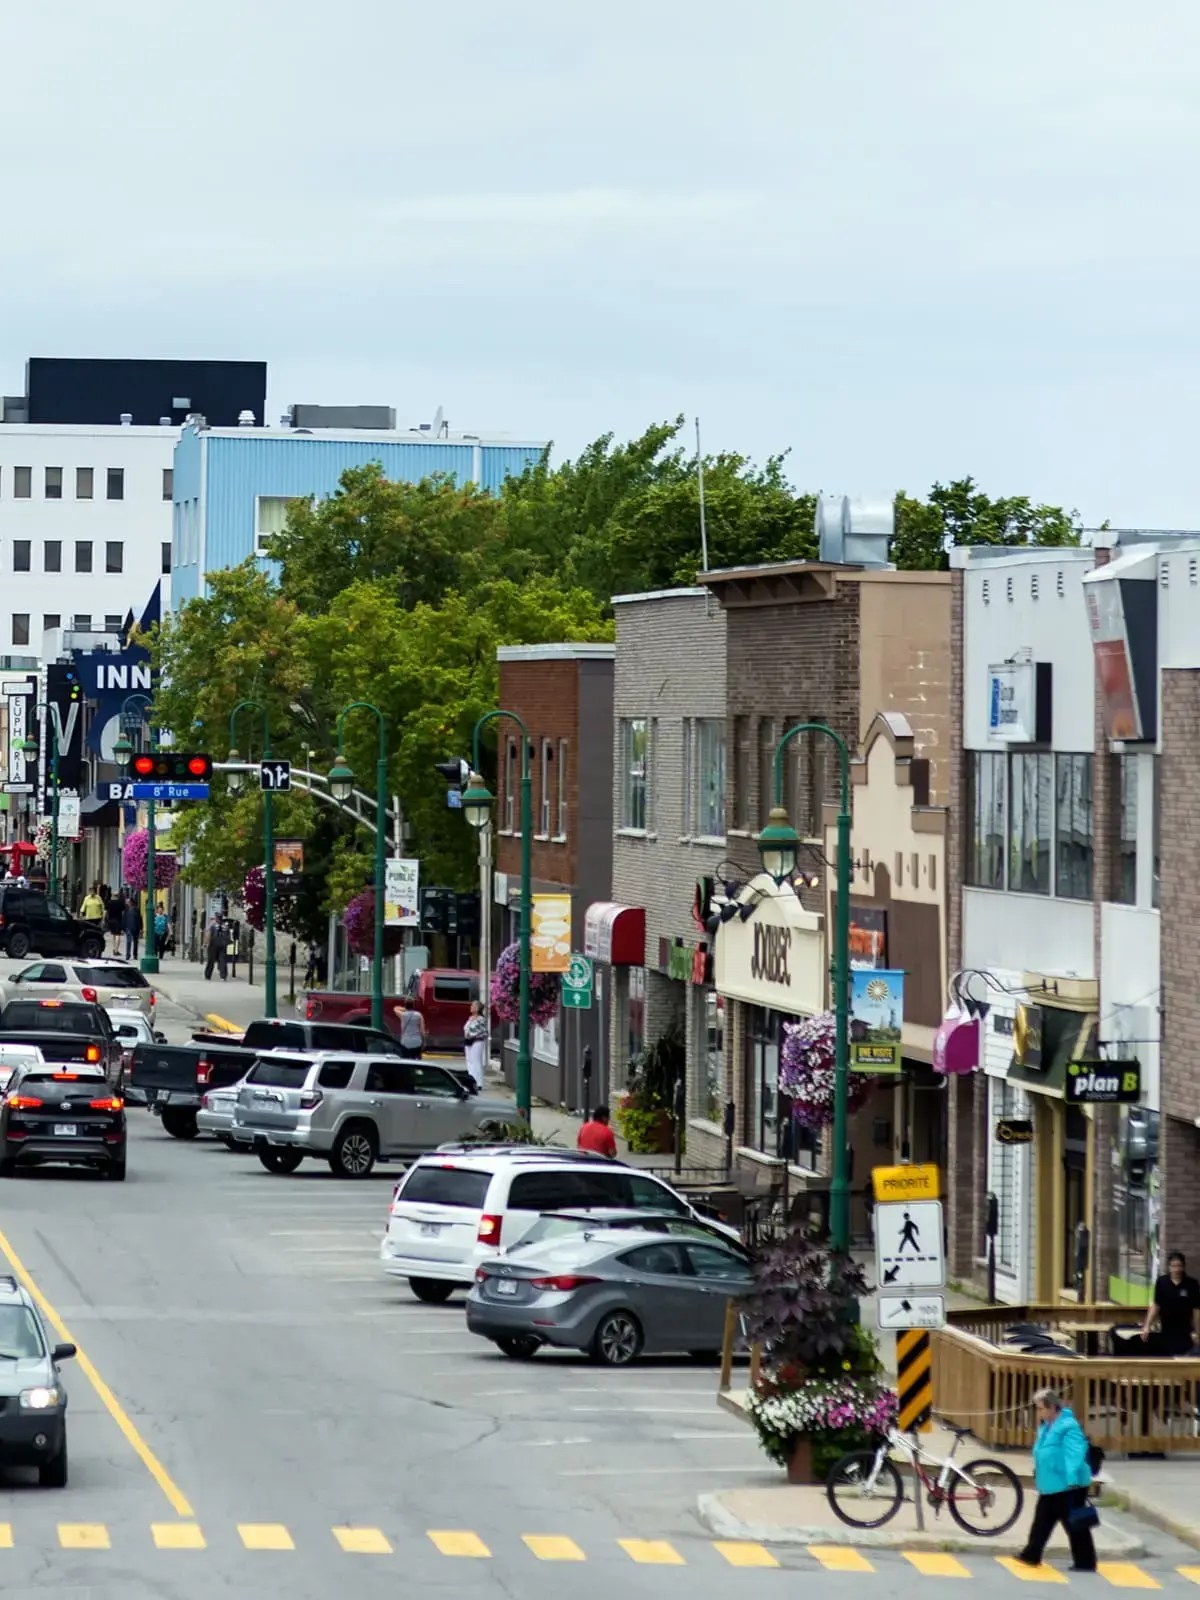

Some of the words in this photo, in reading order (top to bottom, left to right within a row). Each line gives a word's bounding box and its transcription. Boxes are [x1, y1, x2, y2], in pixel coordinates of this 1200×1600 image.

[96, 665, 151, 689] INN
[168, 786, 190, 797] Rue
[1074, 1073, 1119, 1095] plan
[1122, 1072, 1137, 1092] B
